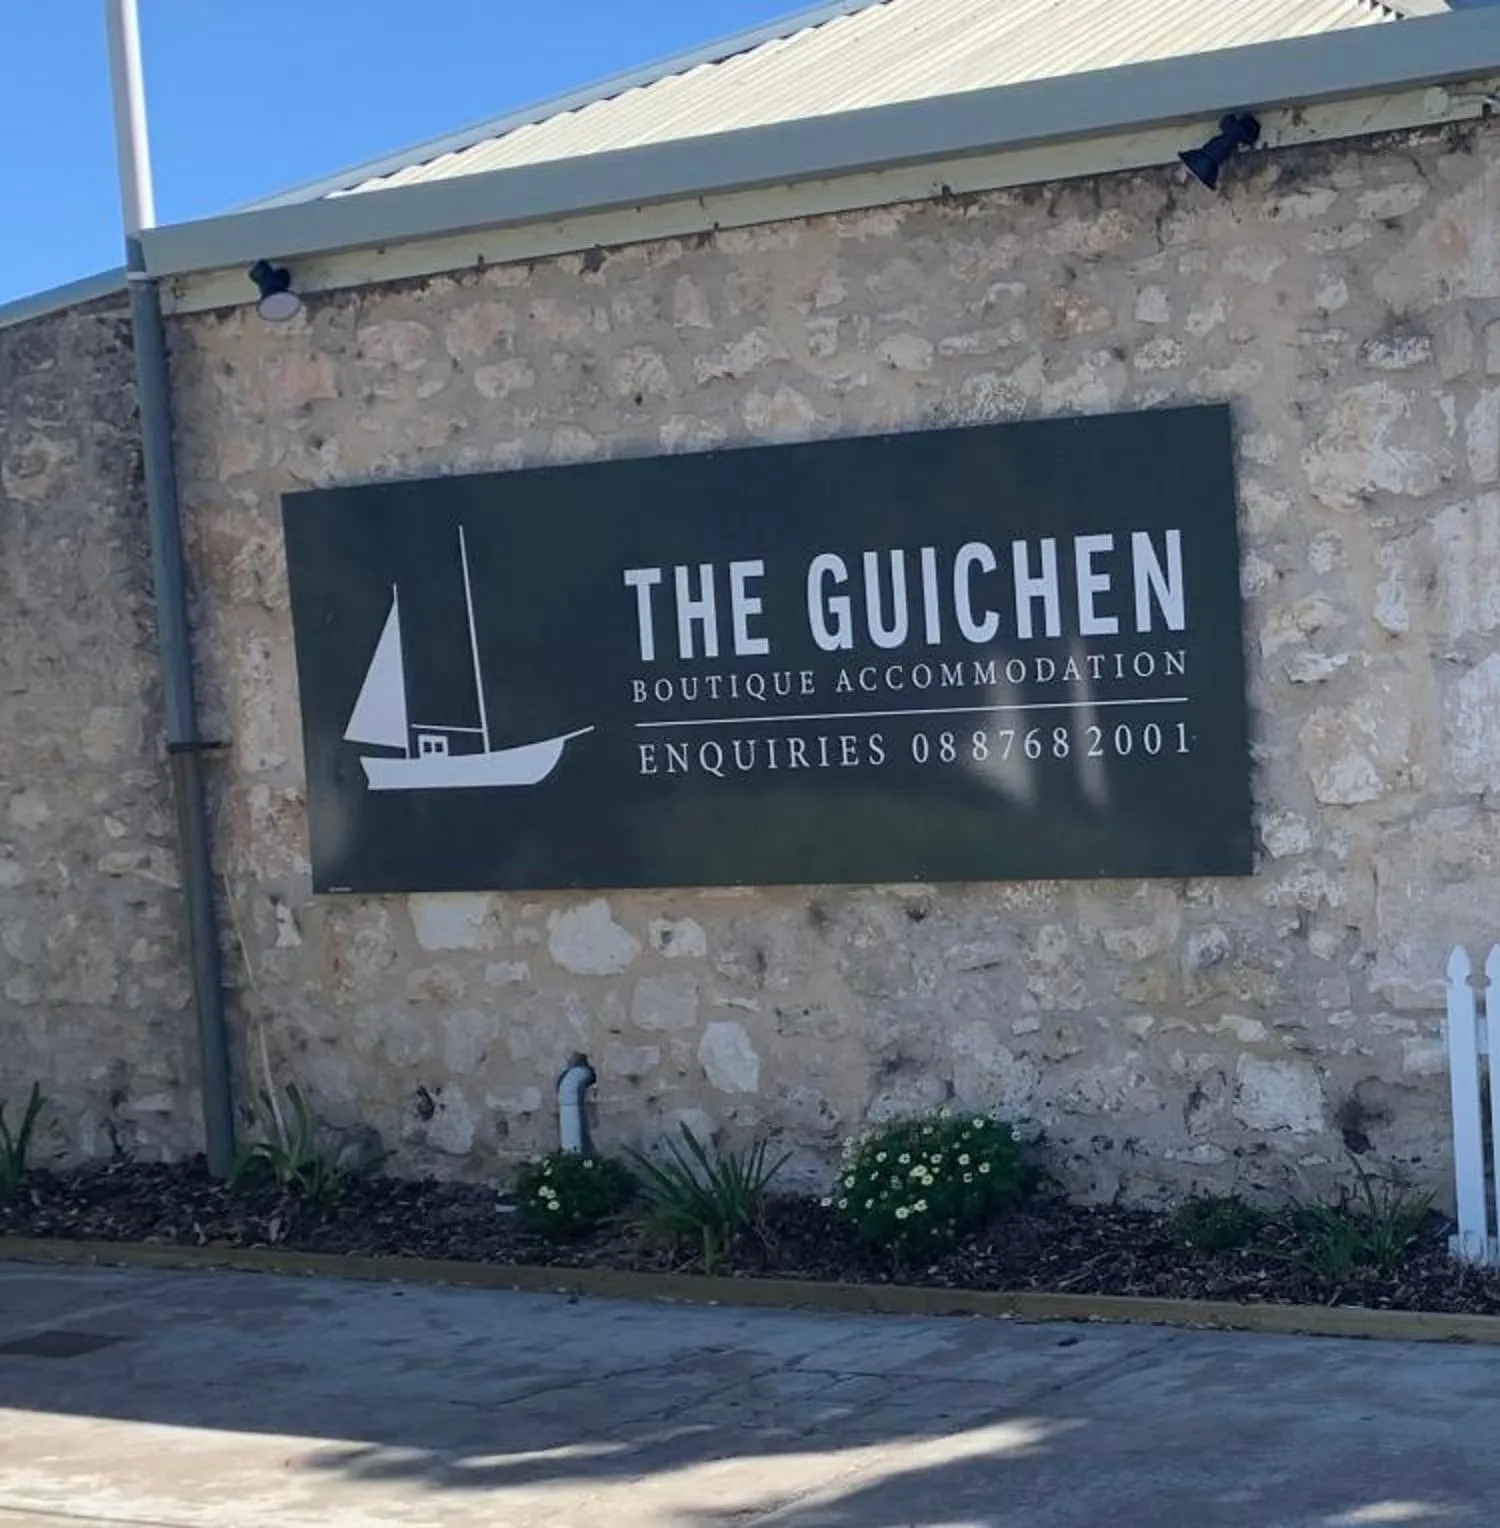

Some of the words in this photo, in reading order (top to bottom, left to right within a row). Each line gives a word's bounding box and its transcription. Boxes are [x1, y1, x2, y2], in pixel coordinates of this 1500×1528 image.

[623, 559, 770, 663] THE
[807, 528, 1187, 652] GUICHEN
[632, 670, 816, 704] BOUTIQUE
[835, 649, 1187, 694] ACCOMMODATION
[639, 733, 887, 777] ENQUIRIES
[911, 731, 958, 765] 08
[972, 727, 1071, 762] 8768
[1083, 722, 1191, 758] 2001
